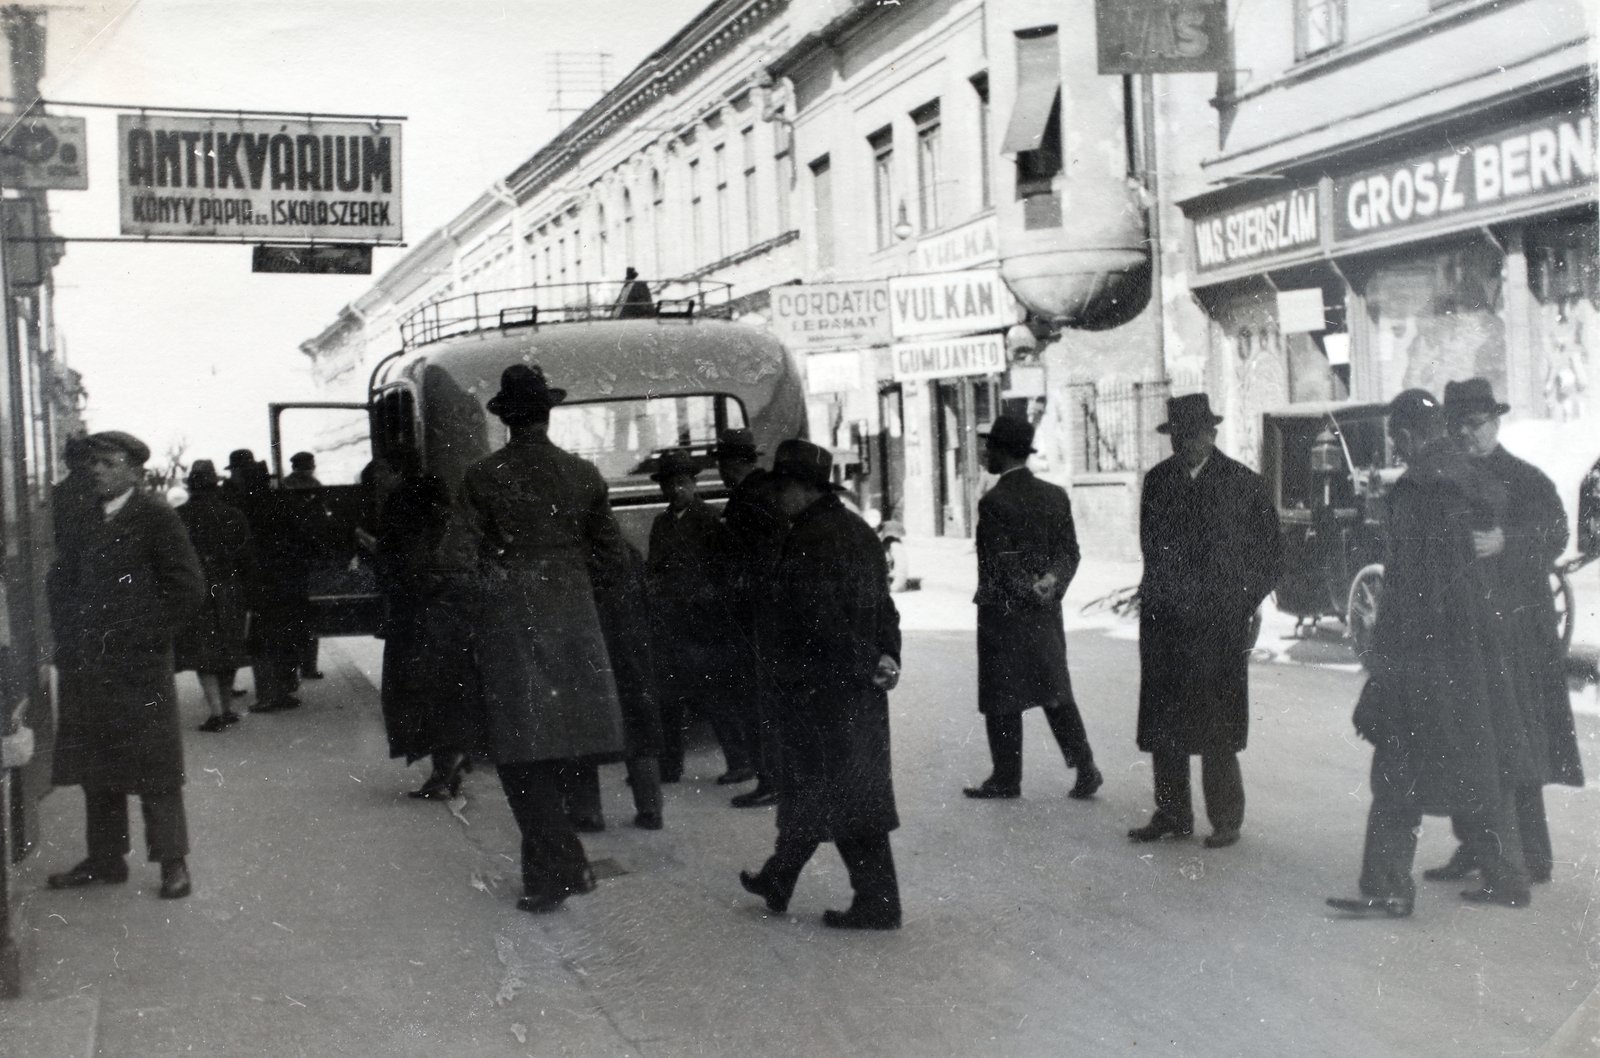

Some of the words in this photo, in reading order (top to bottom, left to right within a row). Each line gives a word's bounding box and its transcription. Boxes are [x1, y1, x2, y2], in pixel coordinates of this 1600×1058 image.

[128, 124, 392, 193] ANTIKVÁRIUM
[1348, 154, 1464, 230] GROSZ
[1226, 189, 1316, 259] SZERSZÁM
[778, 288, 887, 317] CORDATIC
